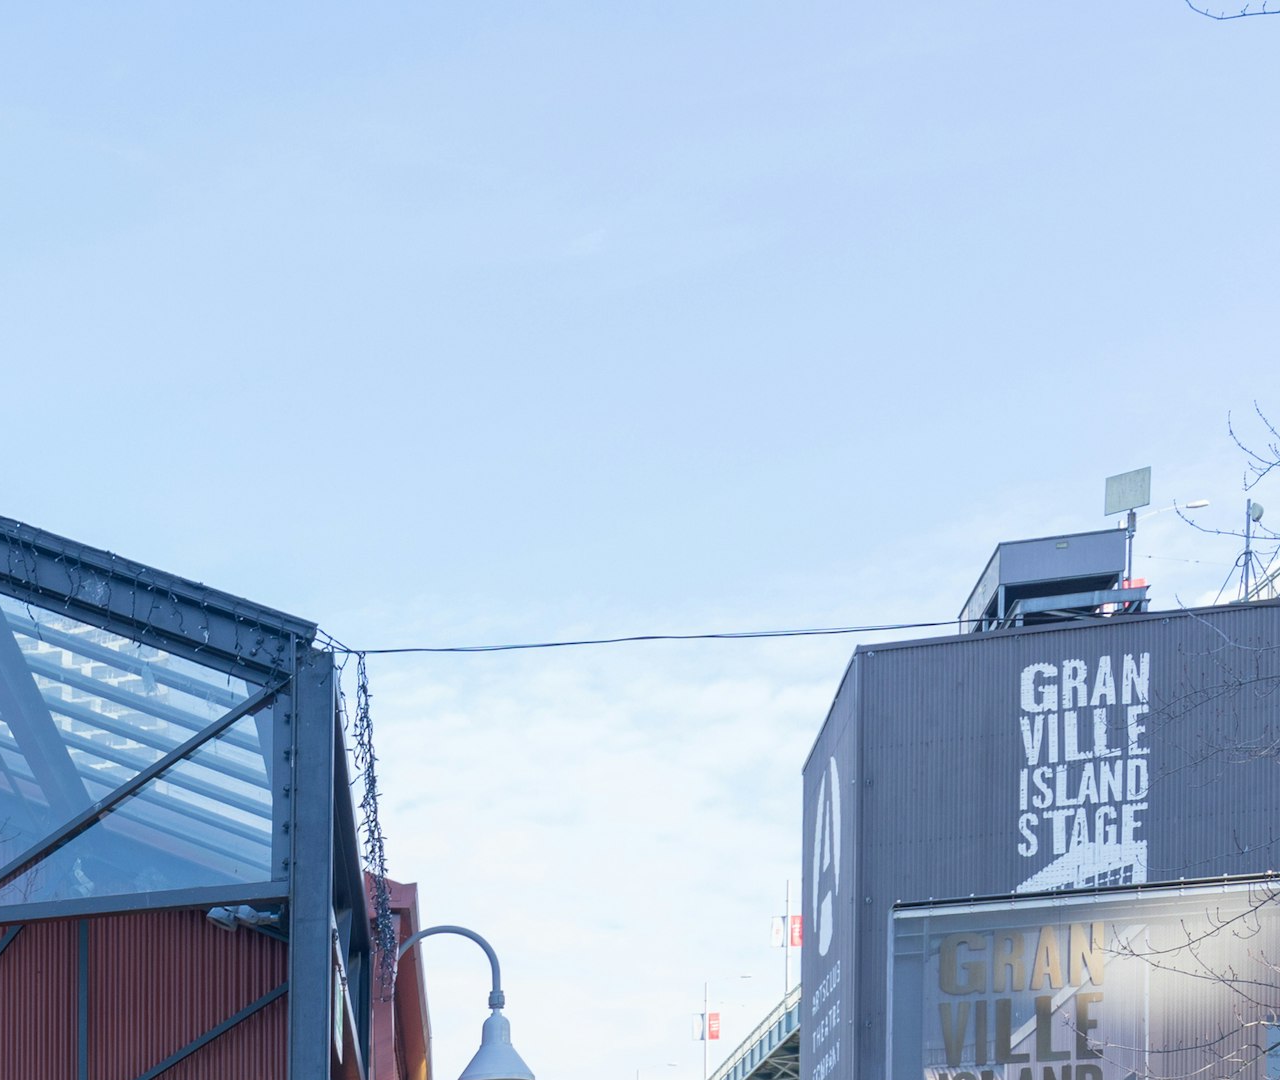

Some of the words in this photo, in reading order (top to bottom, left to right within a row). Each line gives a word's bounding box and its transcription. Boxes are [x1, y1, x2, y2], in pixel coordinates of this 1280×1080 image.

[1020, 652, 1150, 712] GRAN
[1019, 704, 1150, 765] VILLE
[1019, 758, 1149, 810] ISLAND
[1018, 802, 1148, 857] STAGE
[939, 922, 1105, 996] GRAN
[938, 992, 1104, 1067] VILLE
